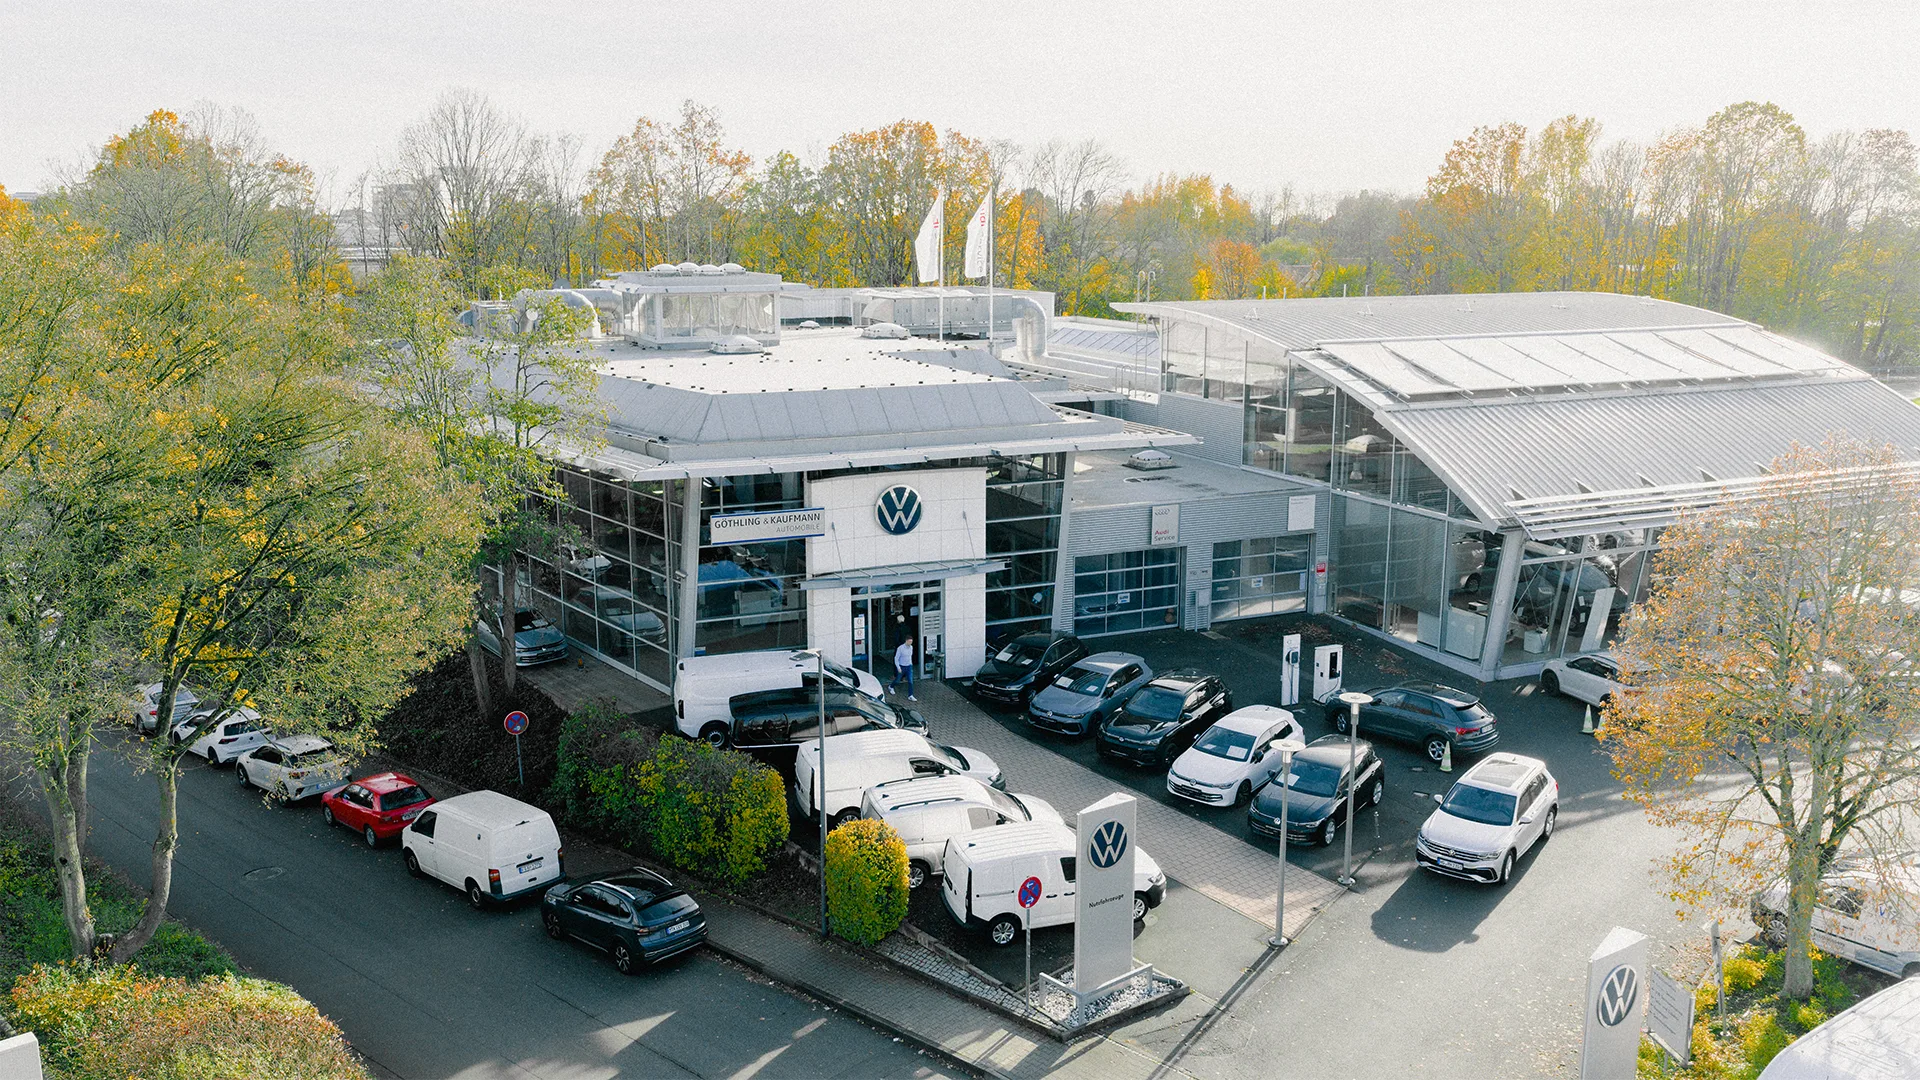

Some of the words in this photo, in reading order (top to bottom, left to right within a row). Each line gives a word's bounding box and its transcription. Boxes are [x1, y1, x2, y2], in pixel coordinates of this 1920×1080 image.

[714, 517, 760, 529] GÖTHLING
[770, 513, 821, 524] KAUFMANN
[876, 485, 922, 533] VW
[776, 523, 820, 533] AUTOMOBILE
[1088, 819, 1127, 868] VW
[1088, 894, 1124, 908] Nutzfahrzeuge
[1598, 965, 1637, 1026] VW
